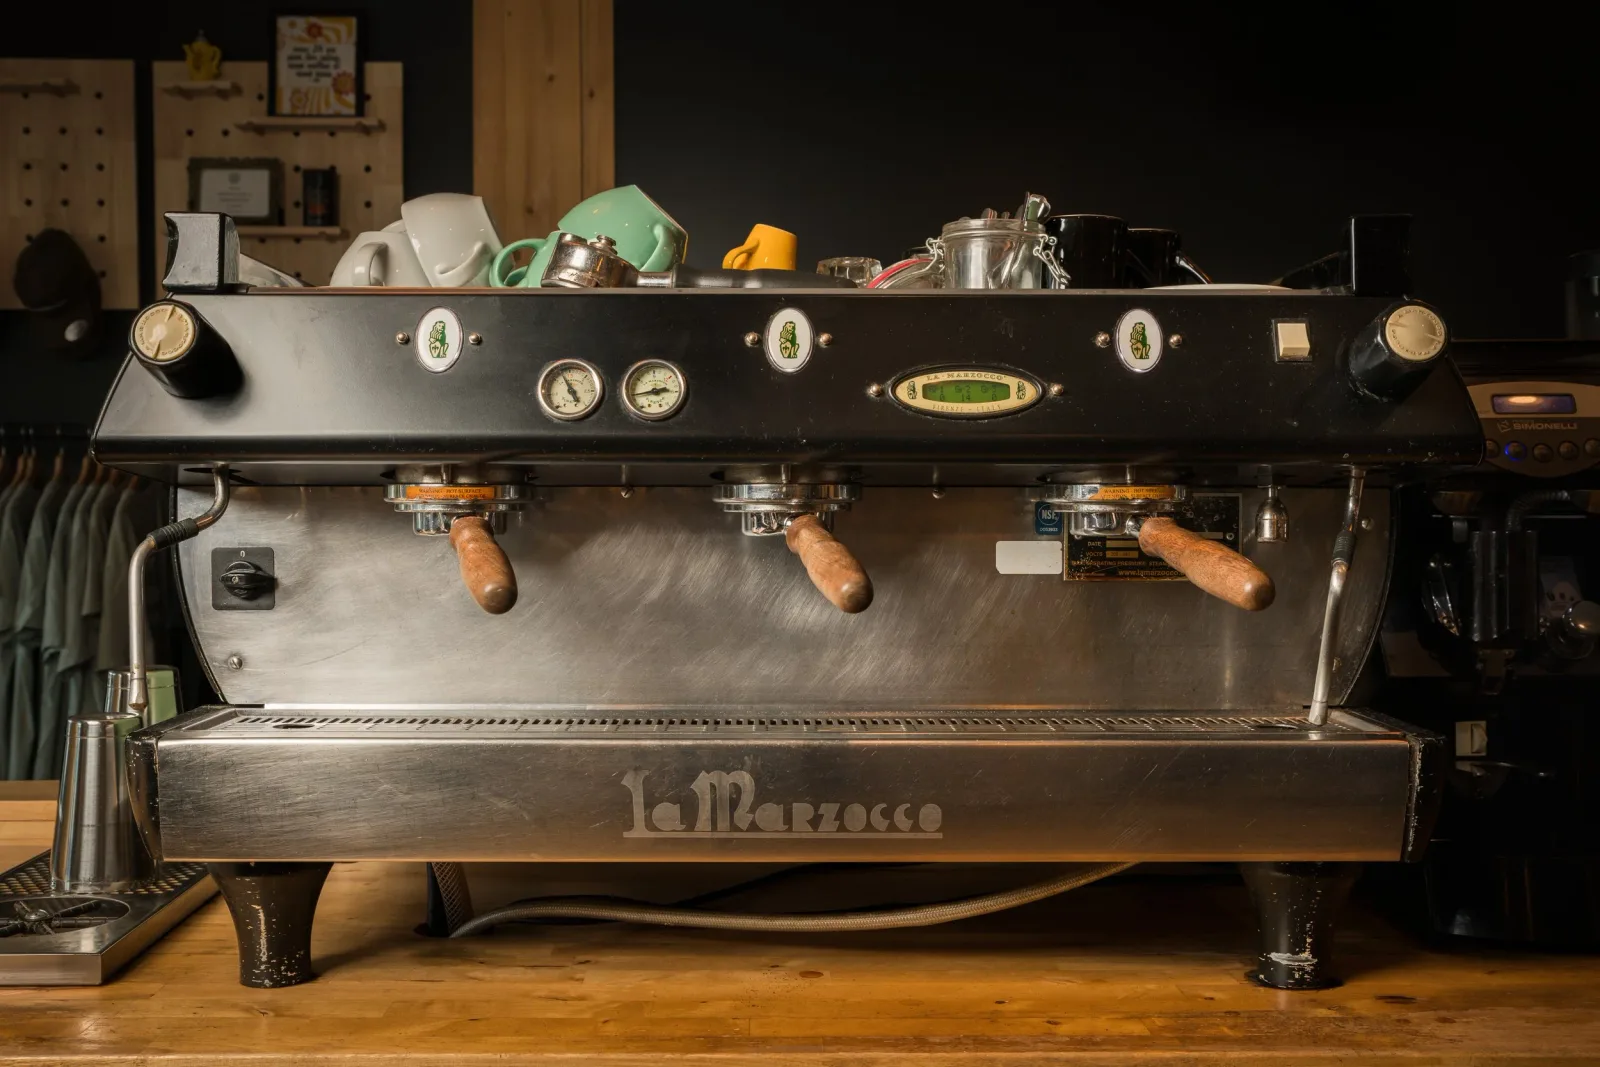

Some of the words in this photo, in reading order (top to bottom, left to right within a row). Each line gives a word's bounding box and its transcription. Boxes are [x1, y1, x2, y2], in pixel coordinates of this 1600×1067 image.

[947, 372, 1004, 381] MARZOCCO
[961, 393, 971, 401] 14
[1513, 422, 1578, 430] SIMONELLI
[1041, 509, 1057, 520] NSF
